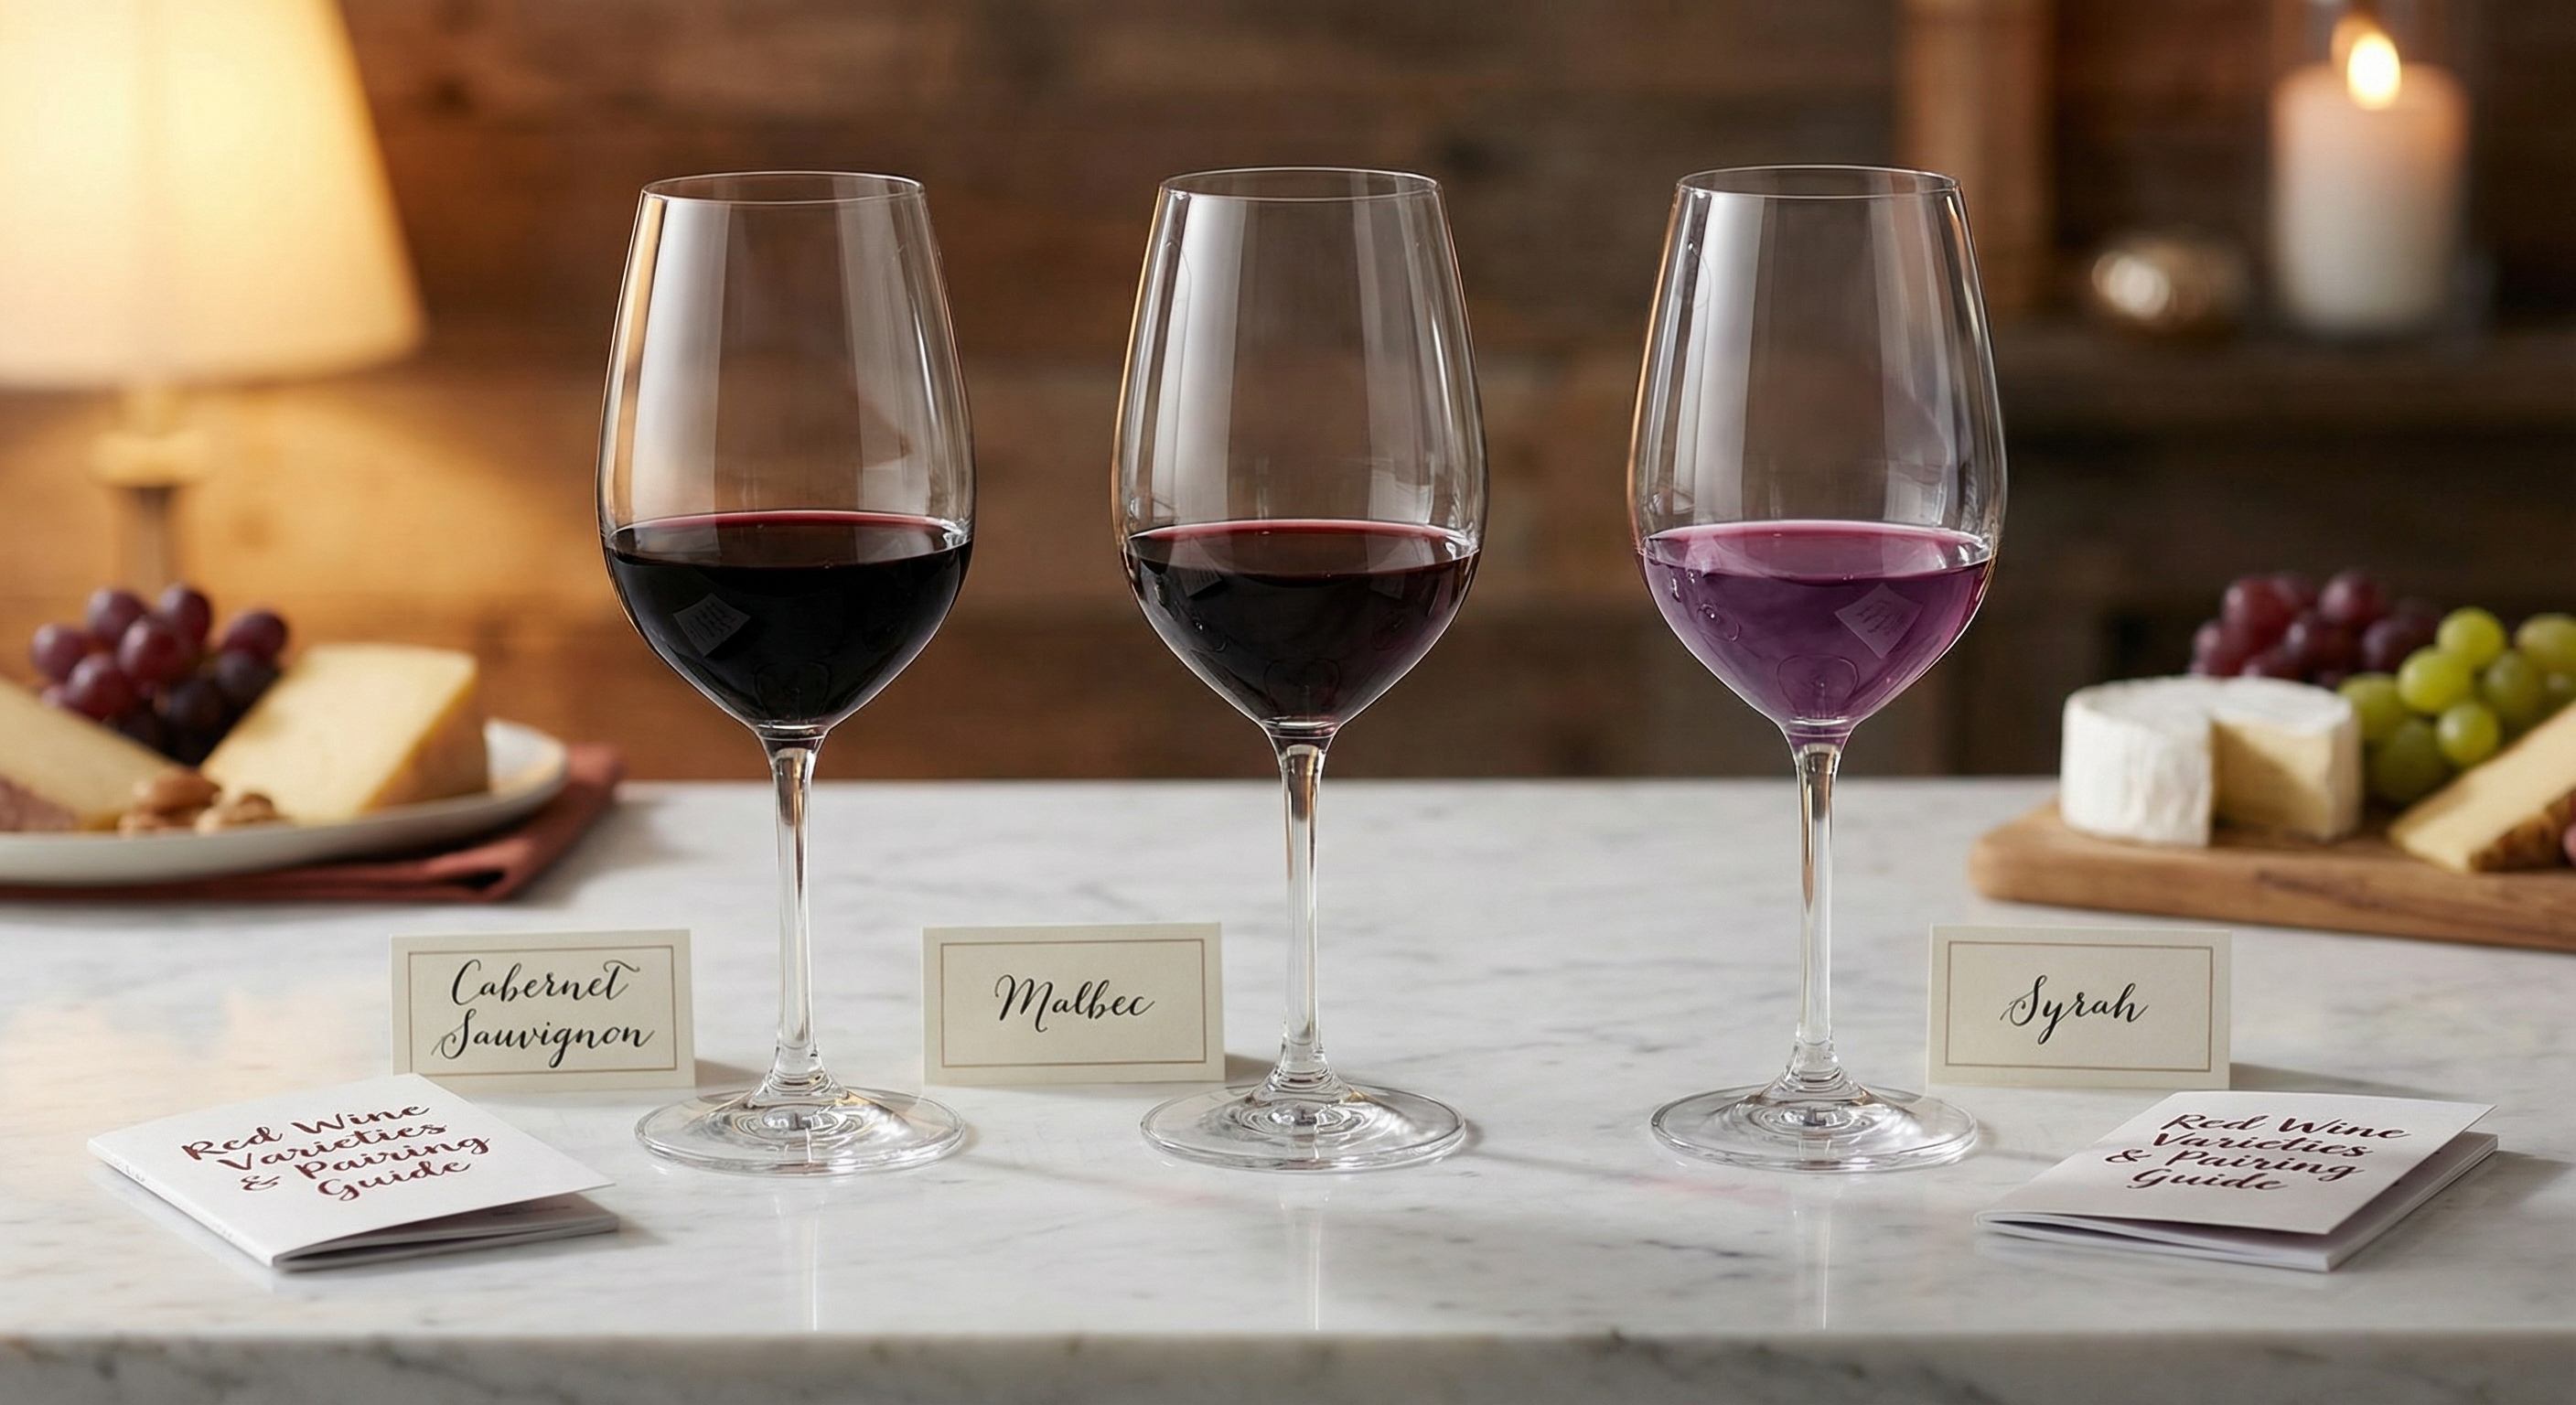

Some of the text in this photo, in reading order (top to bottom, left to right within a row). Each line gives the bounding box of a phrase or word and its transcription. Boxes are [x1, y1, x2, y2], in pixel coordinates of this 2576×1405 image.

[451, 958, 640, 1006] Cabernet
[993, 973, 1156, 1034] Malbec
[2000, 974, 2149, 1045] Syrah
[431, 1008, 656, 1068] Sauvignon
[181, 1104, 430, 1161] Red Wine
[217, 1120, 448, 1172] Varieties
[2152, 1132, 2374, 1158] Varieties
[2160, 1112, 2411, 1140] Red Wine
[241, 1135, 490, 1192] & Pairing
[317, 1159, 472, 1201] Guide
[2104, 1147, 2366, 1182] & Pairing
[2125, 1167, 2289, 1191] Guide
